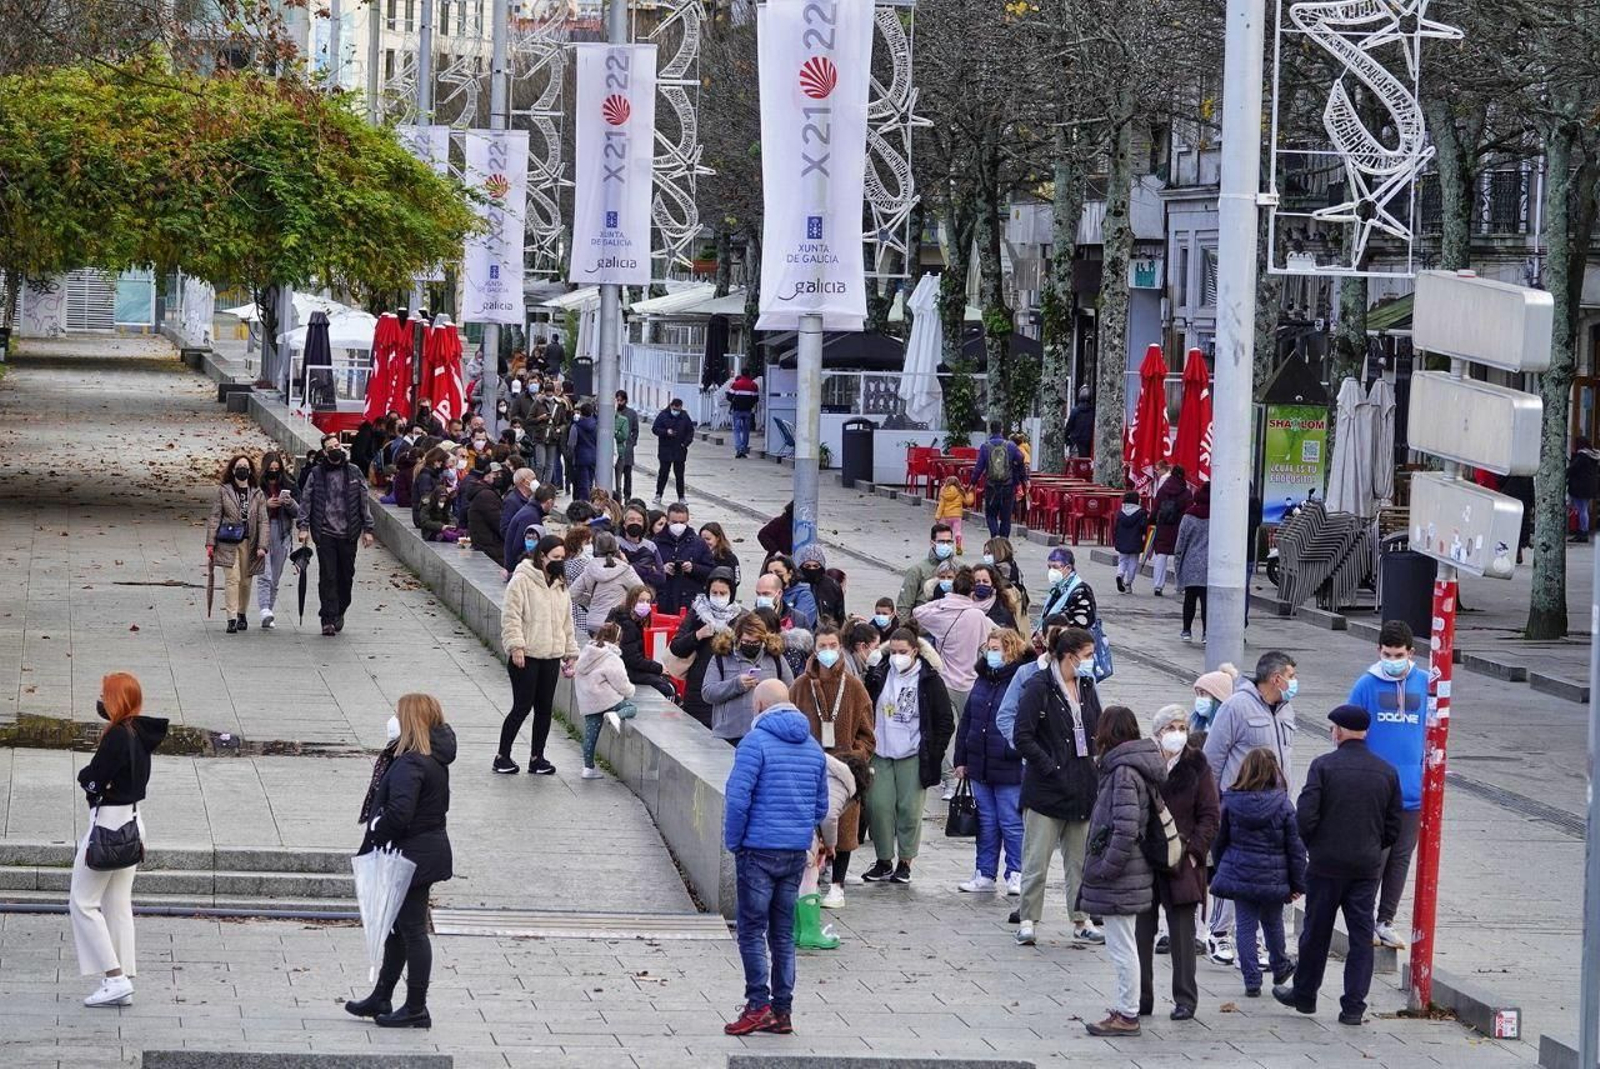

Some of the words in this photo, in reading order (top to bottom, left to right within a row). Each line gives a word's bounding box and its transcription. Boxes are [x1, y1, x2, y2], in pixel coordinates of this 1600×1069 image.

[798, 244, 830, 253] XUNTA
[588, 256, 637, 273] galicia
[786, 254, 800, 264] DE
[801, 254, 839, 264] GALICIA
[782, 278, 846, 300] galicia
